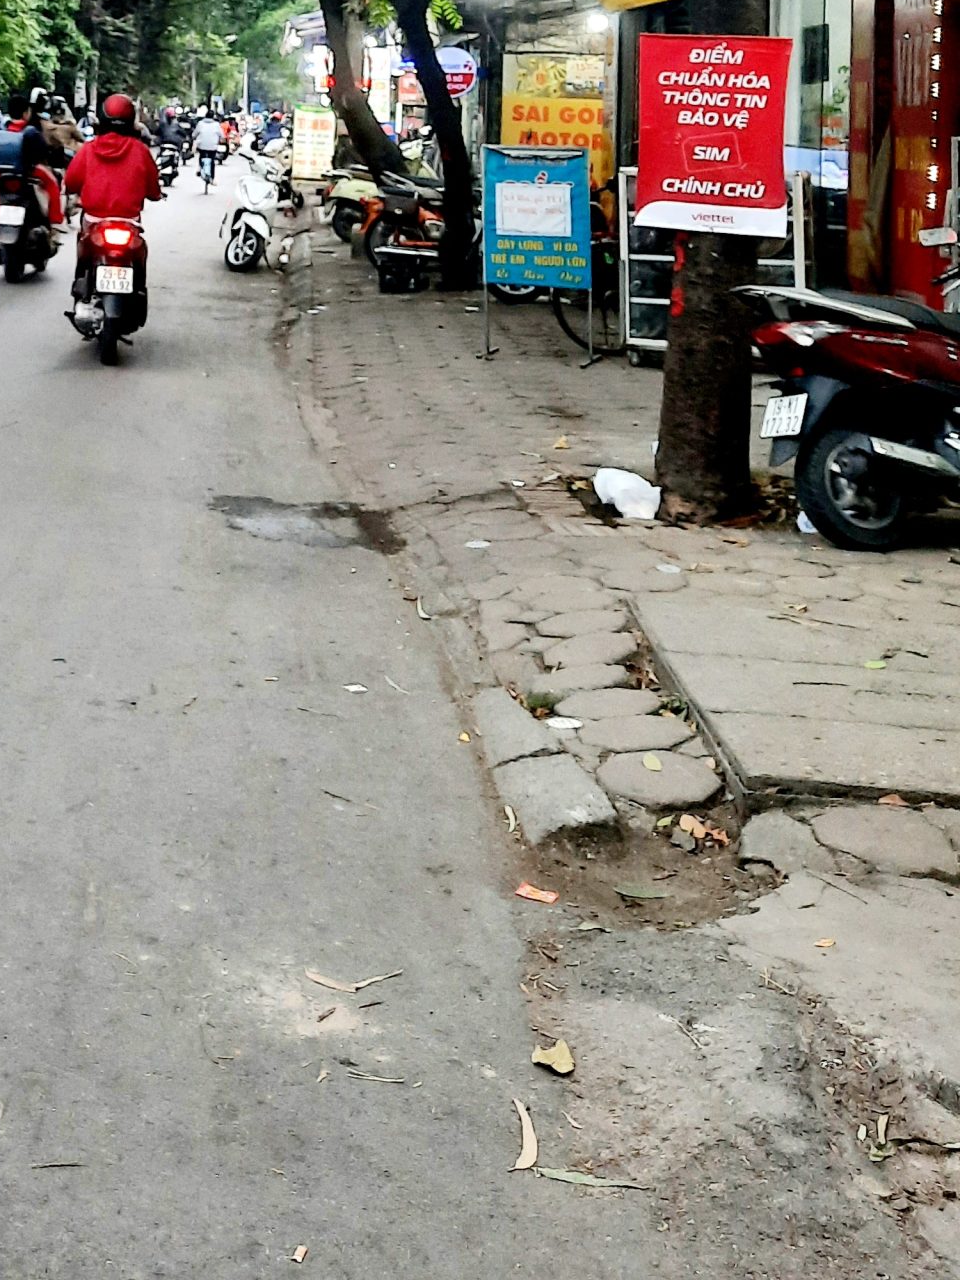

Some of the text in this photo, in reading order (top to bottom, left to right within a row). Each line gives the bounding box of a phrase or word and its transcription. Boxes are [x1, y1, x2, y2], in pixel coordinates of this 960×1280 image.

[688, 41, 744, 65] ĐIỂM
[657, 65, 771, 89] CHUẨN HÓA
[662, 87, 768, 108] THÔNG TIN
[511, 104, 550, 122] SAI
[677, 107, 750, 130] BẢO VỆ
[692, 145, 731, 162] SIM
[661, 175, 766, 199] CHÍNH CHỦ
[691, 211, 735, 225] viettel
